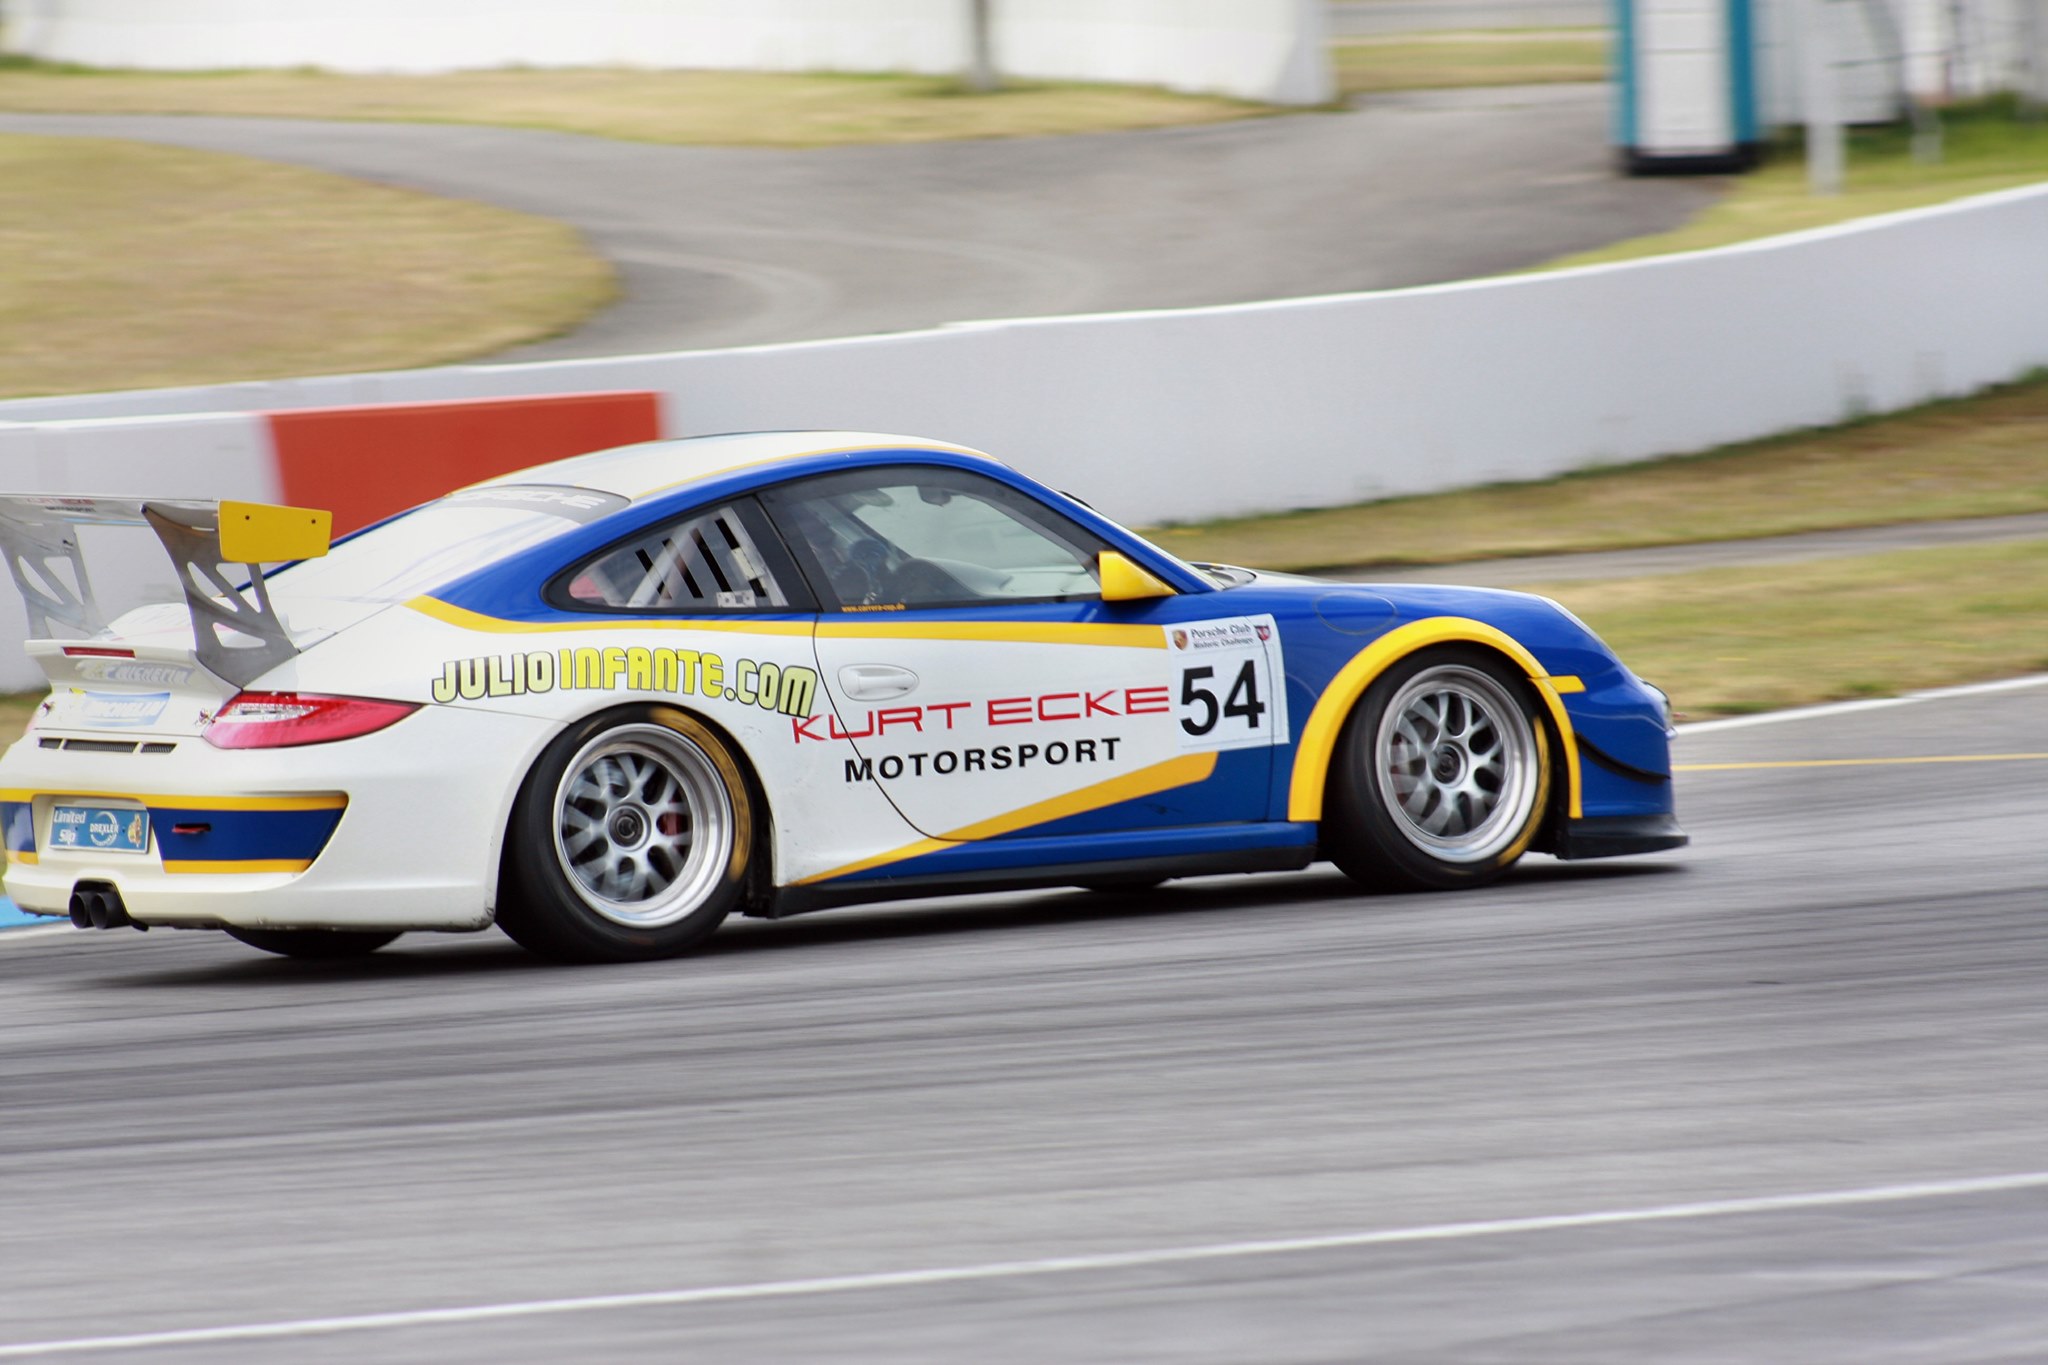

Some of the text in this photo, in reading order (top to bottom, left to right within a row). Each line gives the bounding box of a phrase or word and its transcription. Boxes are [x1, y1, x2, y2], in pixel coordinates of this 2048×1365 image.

[1190, 623, 1251, 639] Porsche Club
[1180, 659, 1265, 736] 54
[791, 686, 1170, 743] KURT ECKE
[845, 737, 1121, 782] MOTORSPORT
[53, 810, 86, 824] Limited
[89, 823, 119, 834] DREXLER
[58, 829, 76, 845] Slip
